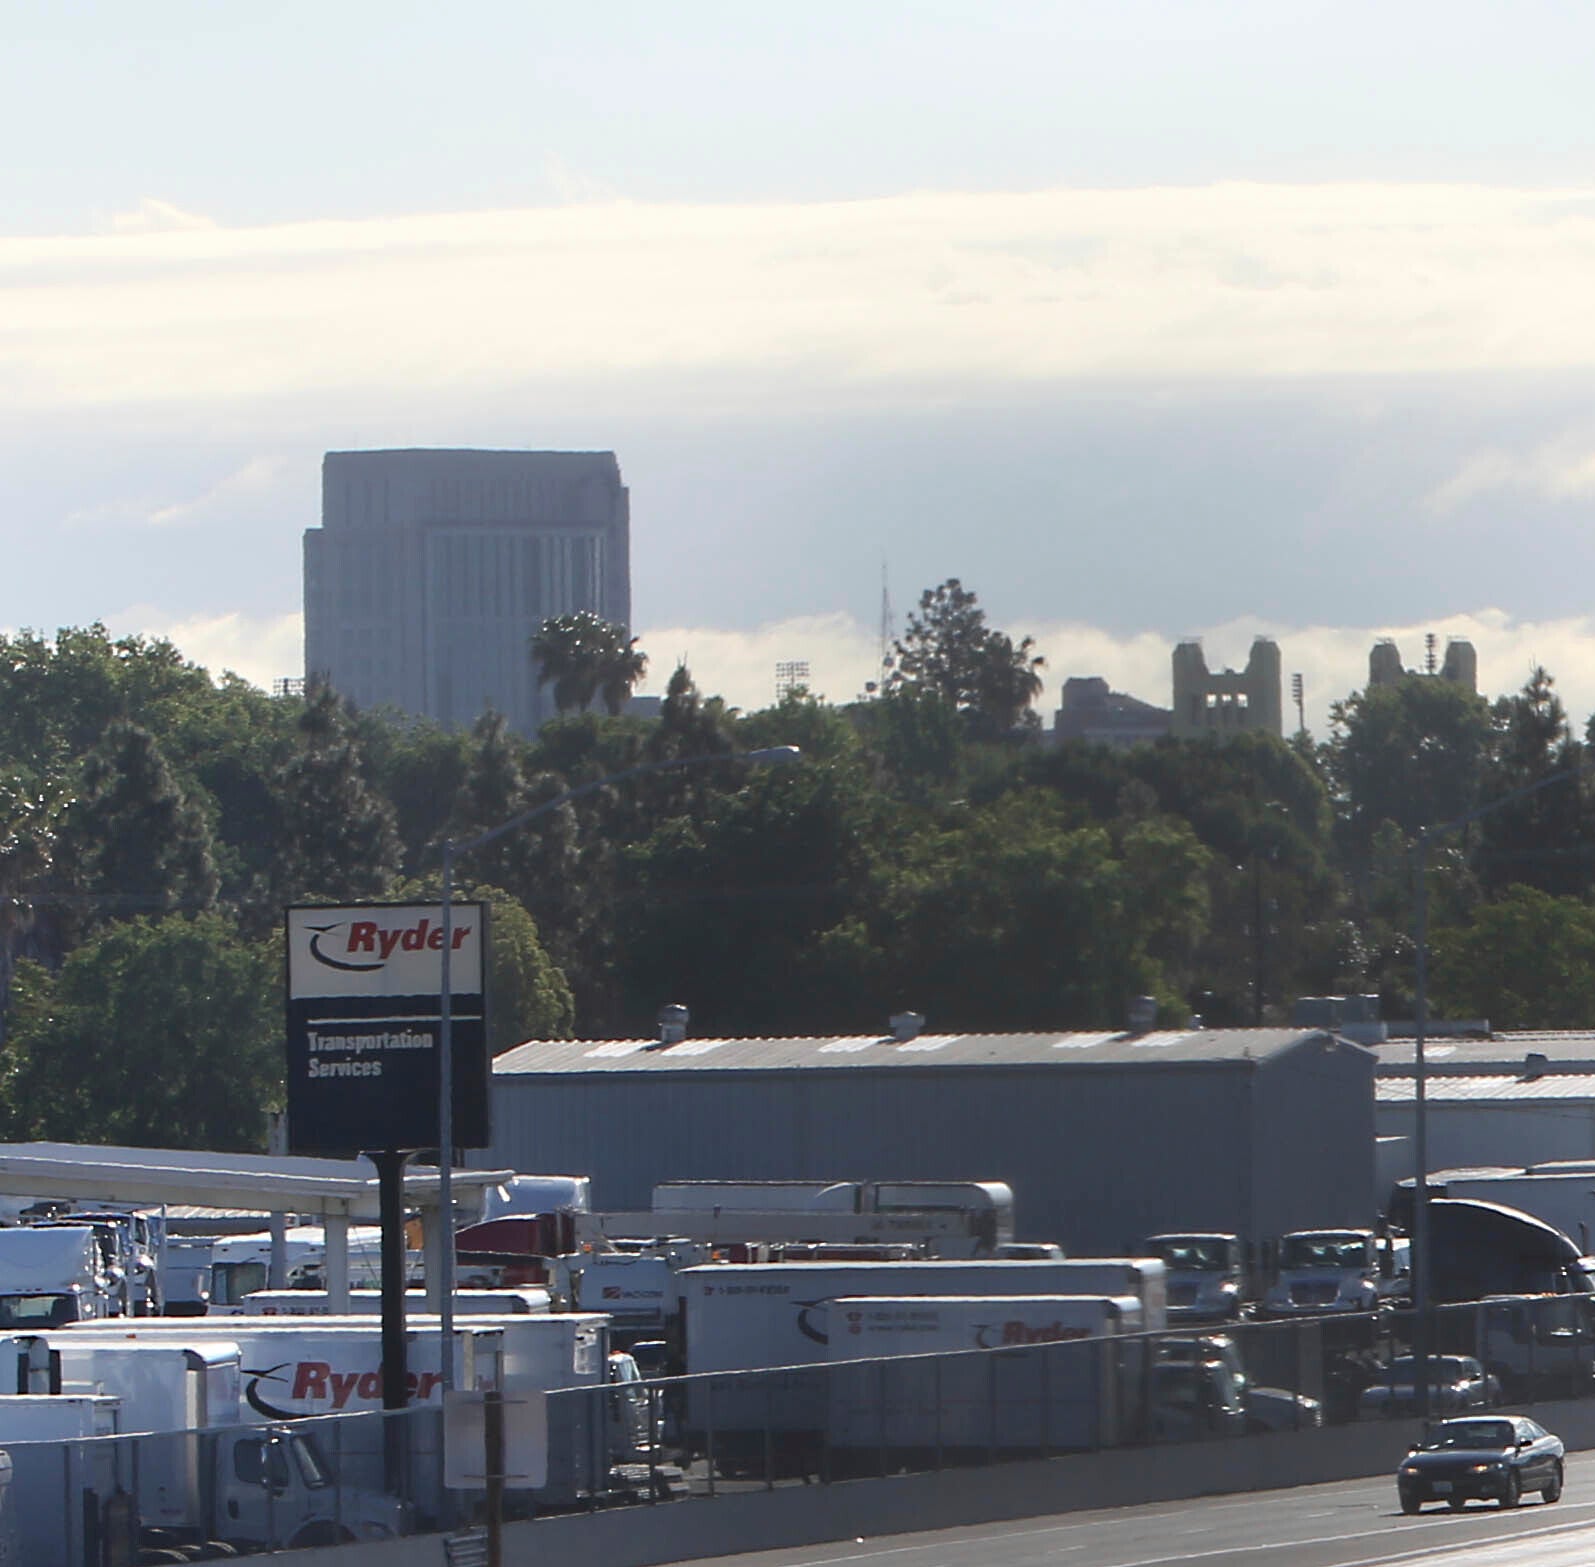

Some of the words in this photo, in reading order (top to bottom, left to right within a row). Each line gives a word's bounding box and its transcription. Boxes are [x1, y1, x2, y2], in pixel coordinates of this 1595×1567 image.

[347, 919, 472, 960] Ryder
[307, 1029, 433, 1053] Transportation
[308, 1057, 382, 1078] Services
